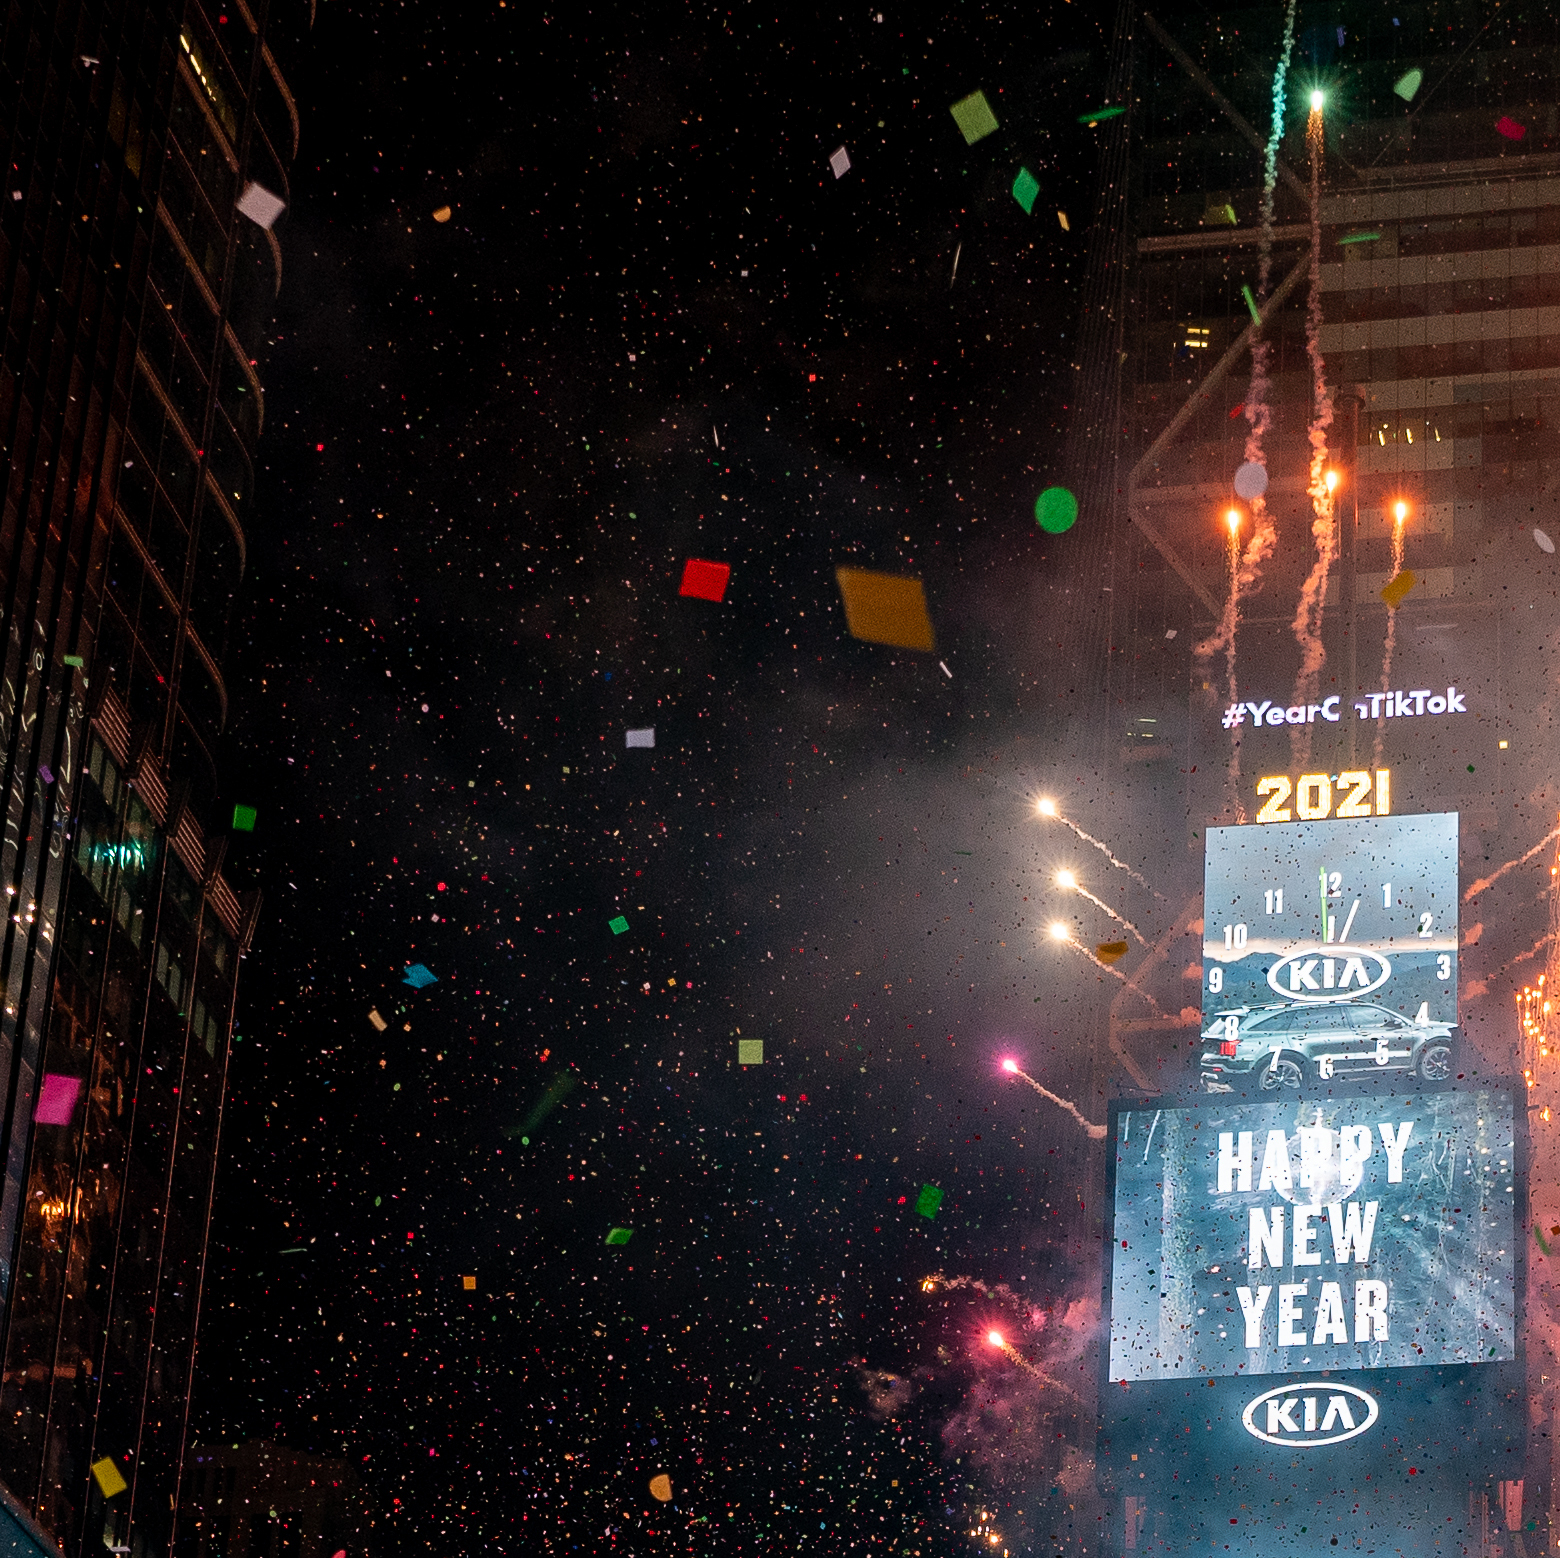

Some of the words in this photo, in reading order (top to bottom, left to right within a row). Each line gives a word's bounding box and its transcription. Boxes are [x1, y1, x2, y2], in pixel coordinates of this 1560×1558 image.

[1255, 768, 1391, 824] 2021
[1319, 871, 1342, 898] 12
[1382, 882, 1392, 908] 1
[1264, 888, 1284, 915] 11
[1223, 923, 1248, 950] 10
[1419, 912, 1433, 938] 2
[1208, 966, 1223, 993] 9
[1288, 957, 1371, 991] KIA
[1436, 954, 1451, 980] 3
[1224, 1015, 1240, 1041] 8
[1415, 1001, 1430, 1028] 4
[1269, 1046, 1282, 1072] 7
[1375, 1039, 1389, 1065] 5
[1319, 1054, 1334, 1080] 6
[1217, 1121, 1414, 1194] HAPPY
[1247, 1200, 1379, 1269] NEW
[1235, 1279, 1389, 1349] YEAR
[1266, 1395, 1357, 1434] KIA
